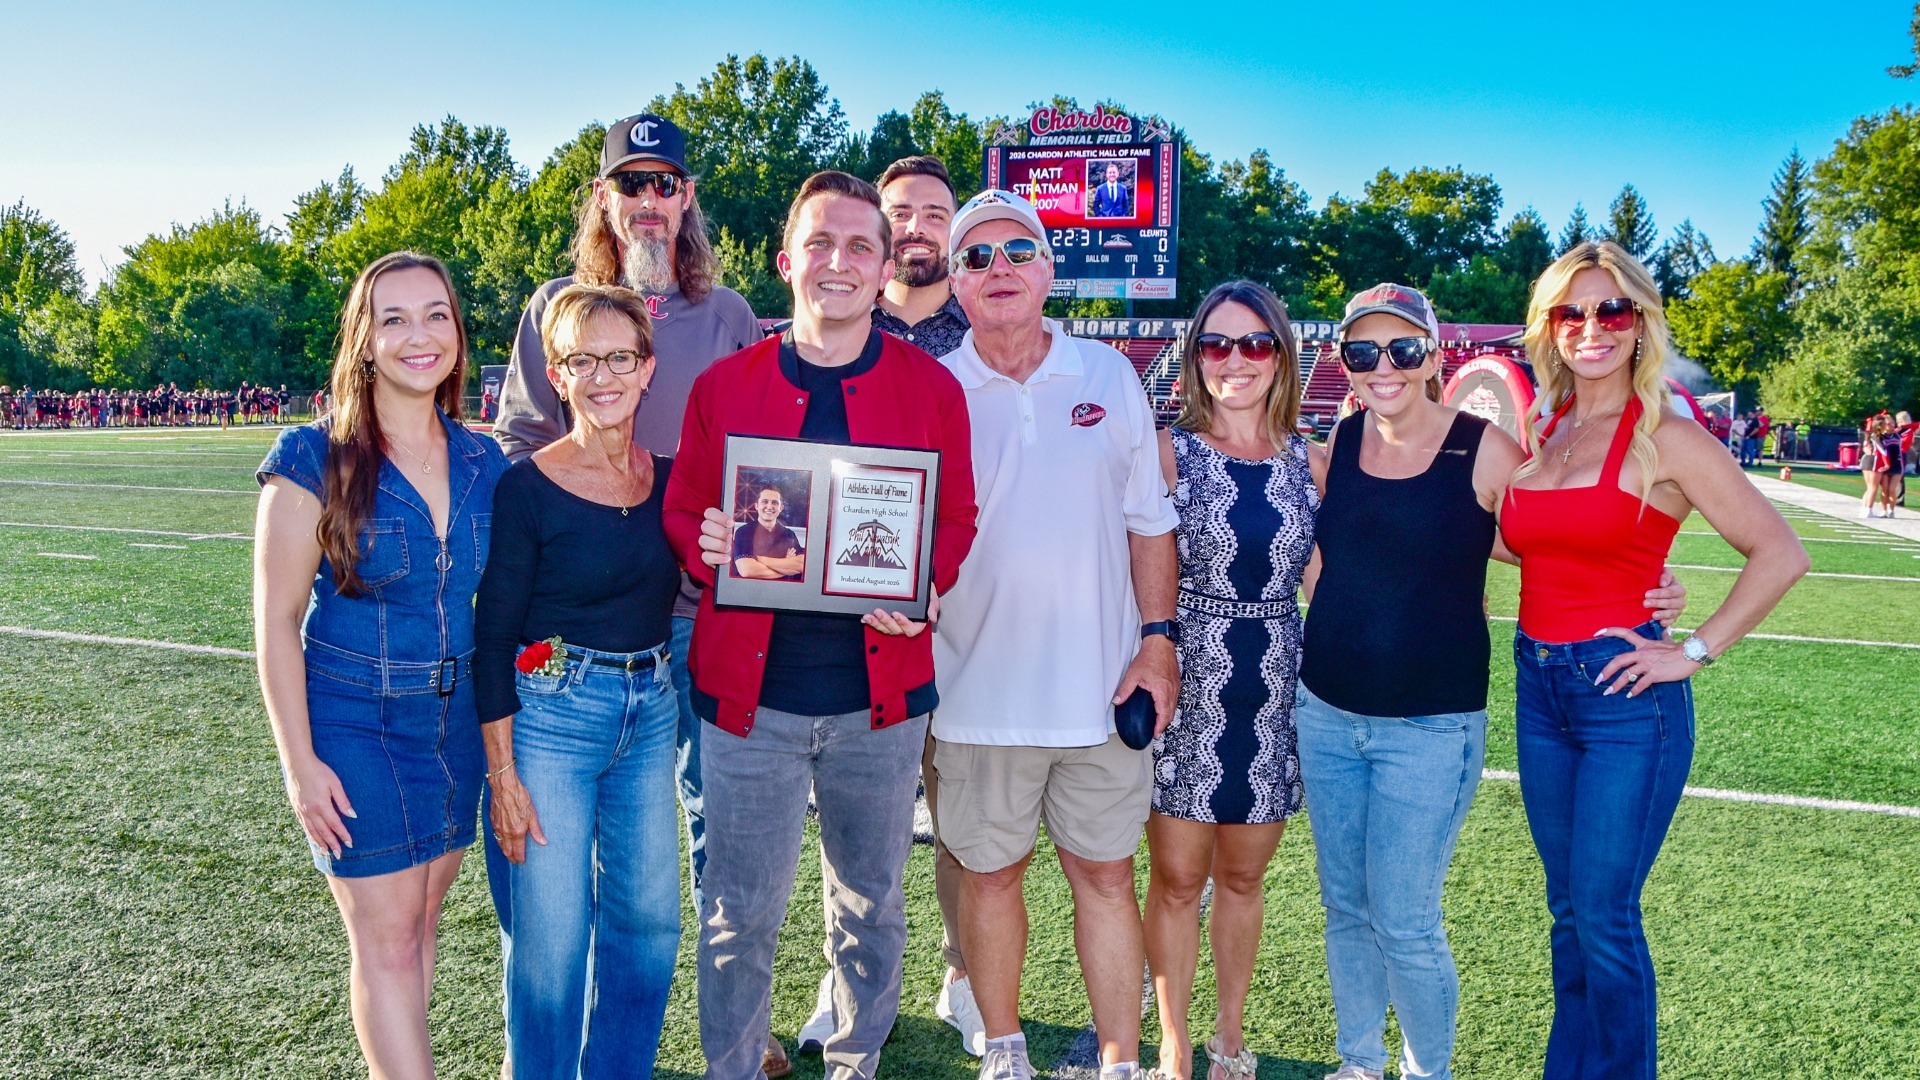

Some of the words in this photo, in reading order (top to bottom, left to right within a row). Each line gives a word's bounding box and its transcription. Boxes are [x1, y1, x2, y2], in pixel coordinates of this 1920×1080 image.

[1030, 103, 1132, 136] Chardon
[1029, 134, 1093, 146] MEMORIAL
[1097, 133, 1132, 144] FIELD
[1009, 151, 1026, 160] 2026
[1027, 150, 1063, 159] CHARDON
[1064, 149, 1097, 158] ATHLETIC
[1099, 149, 1117, 157] HALL
[1130, 148, 1151, 156] FAME
[1028, 167, 1063, 180] MATT
[1012, 182, 1078, 195] STRATMAN
[1161, 145, 1169, 225] HILLTOPPERS
[1034, 198, 1059, 210] 2007
[1158, 237, 1168, 253] 0
[1056, 254, 1065, 263] GO
[1085, 254, 1099, 263] BALL
[1100, 254, 1109, 262] ON
[1125, 254, 1138, 263] QTR
[1153, 254, 1169, 263] T.O.L.
[1131, 263, 1136, 276] 1
[1157, 264, 1164, 276] 3
[1135, 282, 1142, 292] 4
[1072, 320, 1129, 336] HOME
[1138, 320, 1164, 336] OF
[847, 483, 869, 494] Athletic
[870, 484, 883, 495] Hall
[884, 485, 892, 499] of
[892, 487, 908, 497] Fame
[843, 505, 870, 515] Chardon
[871, 507, 887, 517] High
[888, 508, 908, 518] School
[840, 575, 865, 584] Inducted
[865, 577, 886, 586] August
